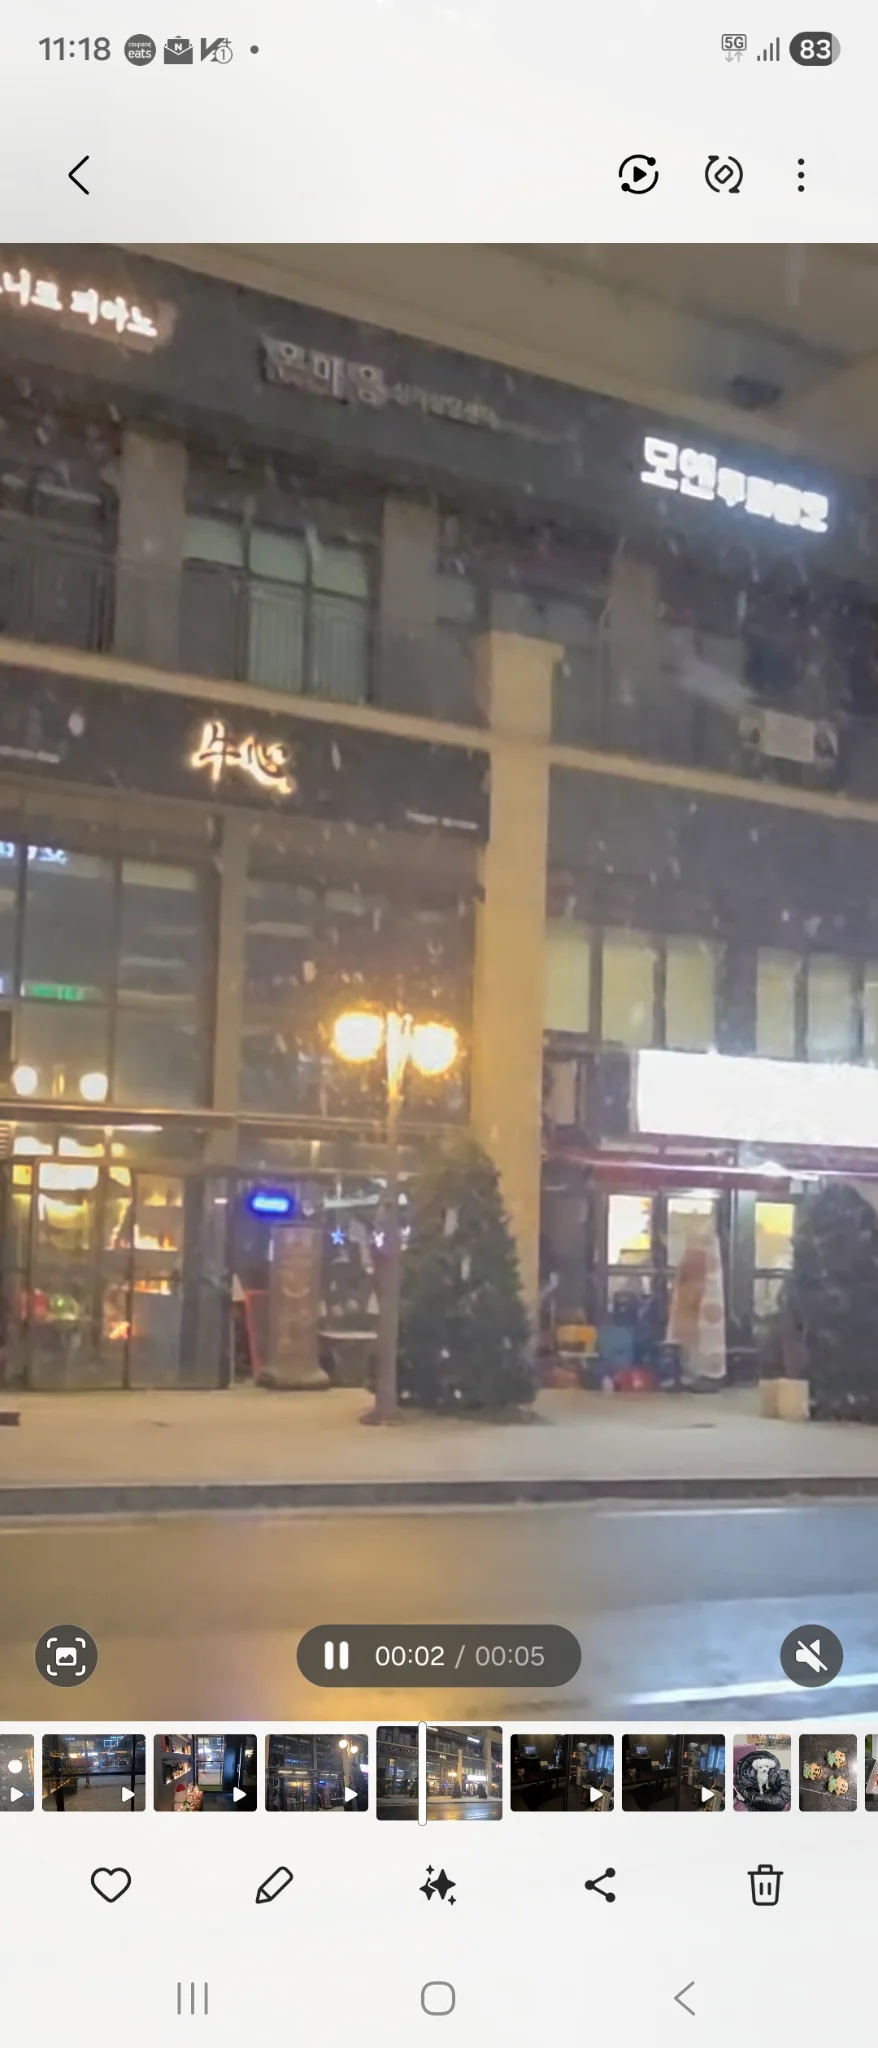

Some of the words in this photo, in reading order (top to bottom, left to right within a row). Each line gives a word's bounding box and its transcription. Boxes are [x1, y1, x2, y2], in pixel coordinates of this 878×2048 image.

[38, 36, 111, 62] 11:18
[724, 36, 745, 49] 5G
[800, 39, 831, 59] 83
[127, 48, 152, 59] eats
[70, 288, 158, 337] 피아노
[375, 1645, 445, 1667] 00:02
[475, 1645, 545, 1667] 00:05
